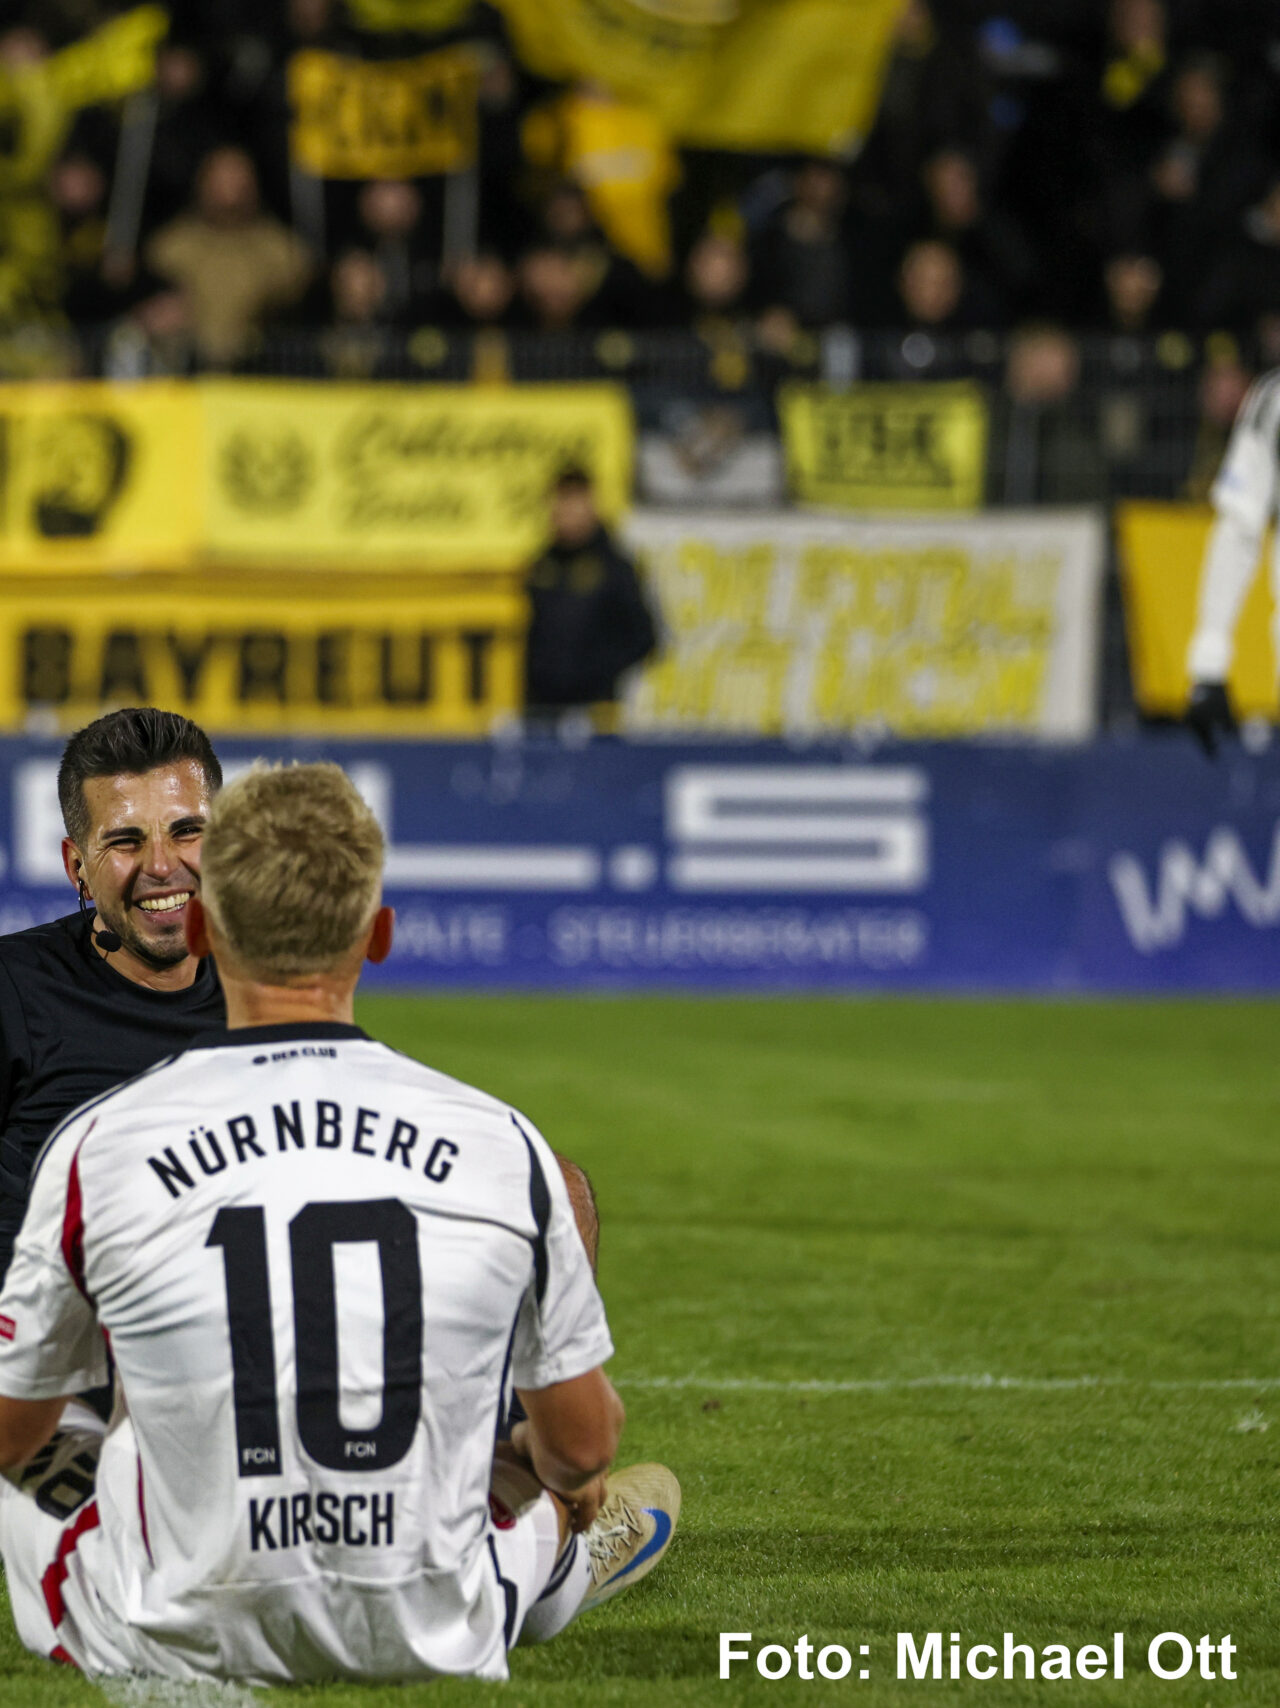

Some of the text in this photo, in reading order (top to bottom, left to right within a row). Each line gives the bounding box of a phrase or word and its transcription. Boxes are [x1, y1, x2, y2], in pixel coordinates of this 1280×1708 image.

[21, 629, 500, 706] BAYREUT
[147, 1100, 460, 1199] NÜRNBERG
[204, 1197, 424, 1478] 10
[242, 1447, 277, 1465] FCN
[344, 1440, 377, 1458] FCN
[249, 1492, 395, 1552] KIRSCH
